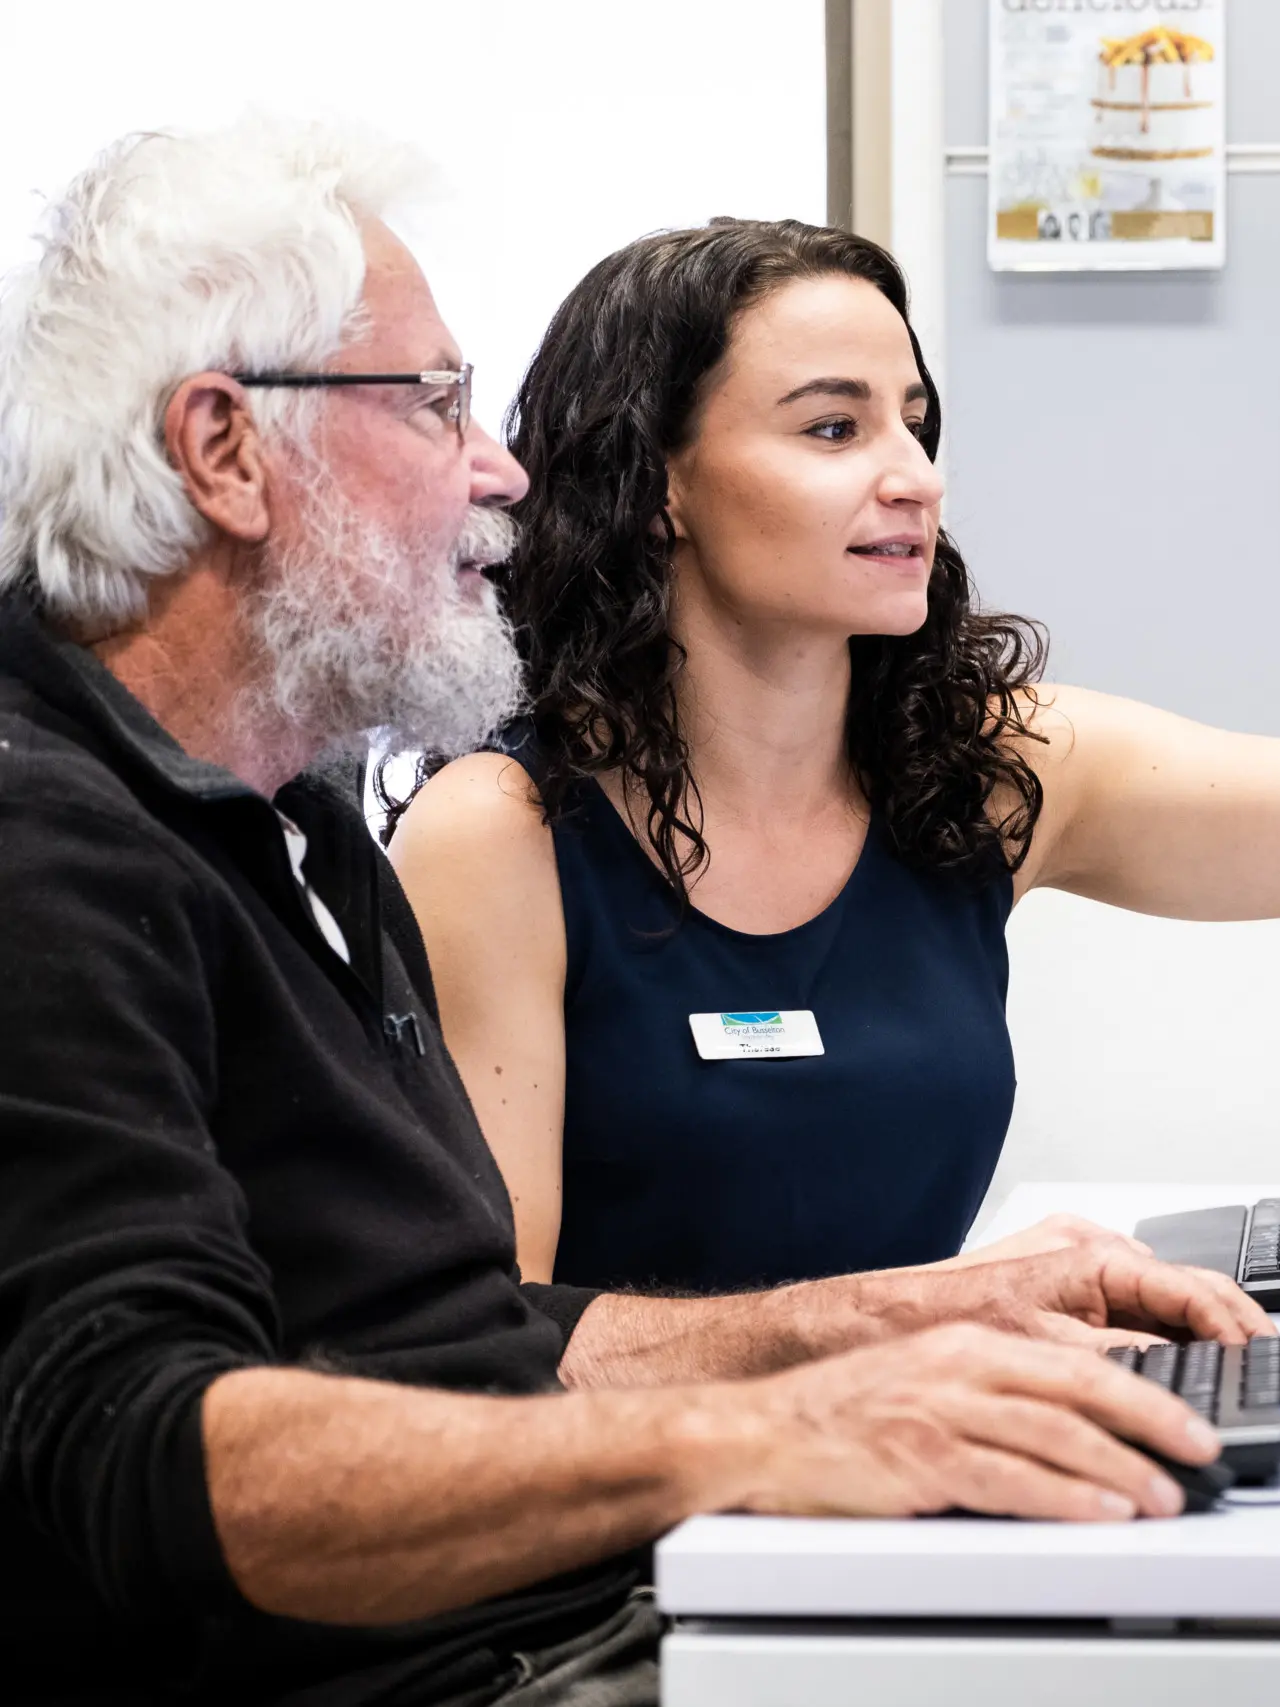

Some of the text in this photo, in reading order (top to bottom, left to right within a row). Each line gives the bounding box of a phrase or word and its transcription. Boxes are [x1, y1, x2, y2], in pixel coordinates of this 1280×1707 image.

[724, 1026, 785, 1036] City of Busselton
